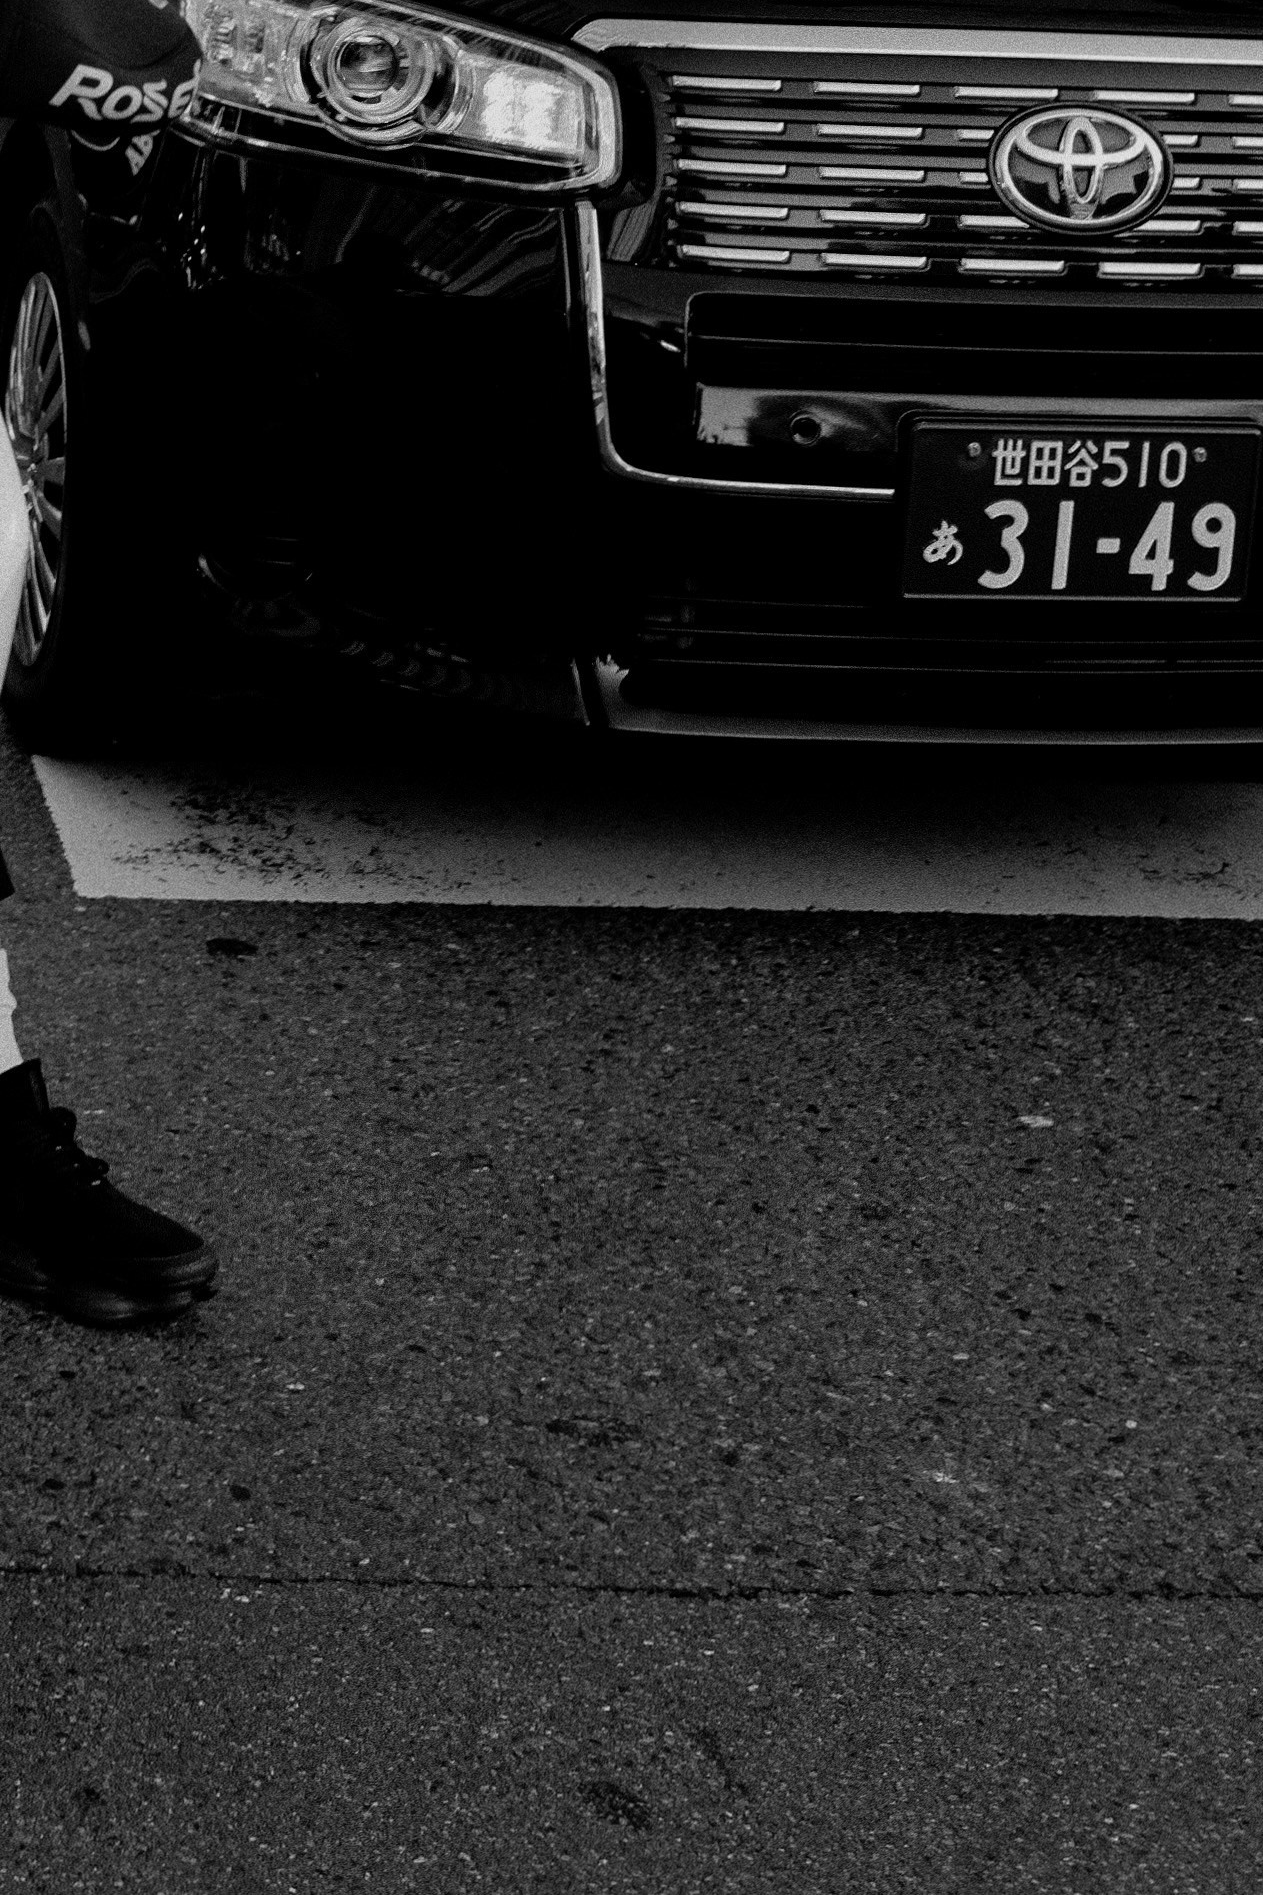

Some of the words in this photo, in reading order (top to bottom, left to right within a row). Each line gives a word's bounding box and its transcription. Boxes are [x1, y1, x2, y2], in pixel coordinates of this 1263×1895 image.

[992, 438, 1188, 489] 世田谷510
[922, 520, 964, 566] あ
[977, 499, 1237, 592] 31-49
